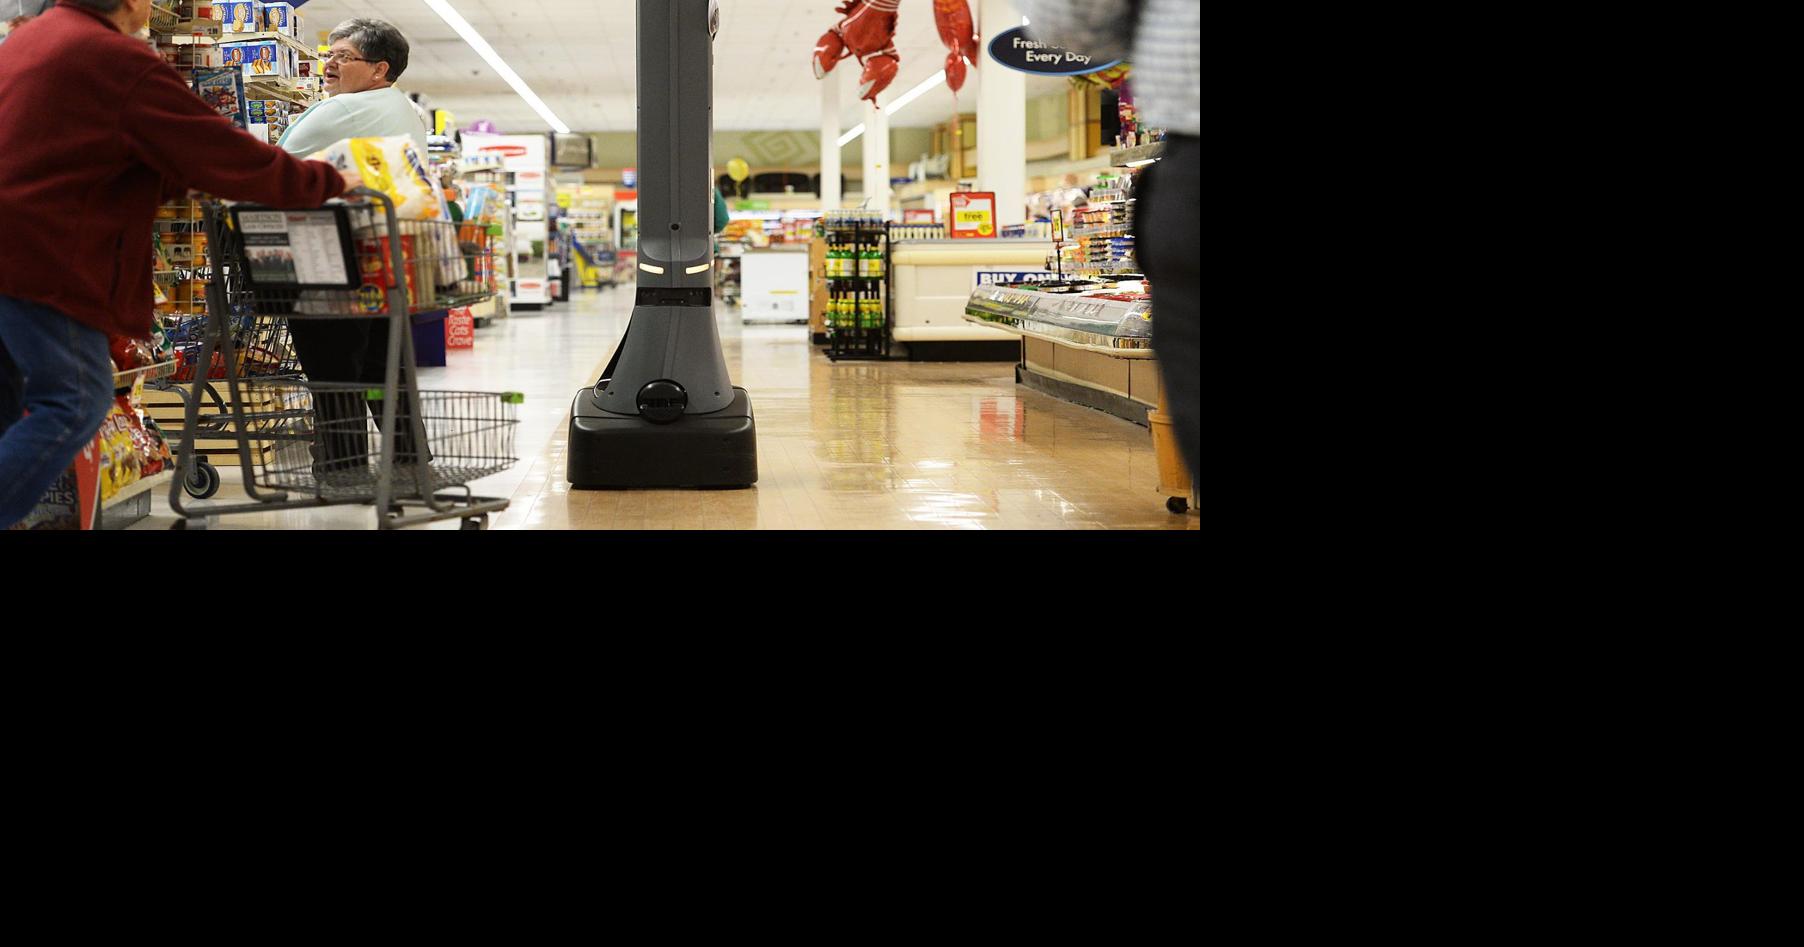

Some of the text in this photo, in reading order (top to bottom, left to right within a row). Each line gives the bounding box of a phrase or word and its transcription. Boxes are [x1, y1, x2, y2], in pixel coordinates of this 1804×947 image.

[1013, 37, 1047, 49] Fresh
[1026, 50, 1092, 65] Every Day
[964, 212, 984, 220] free
[980, 273, 1017, 284] BUY
